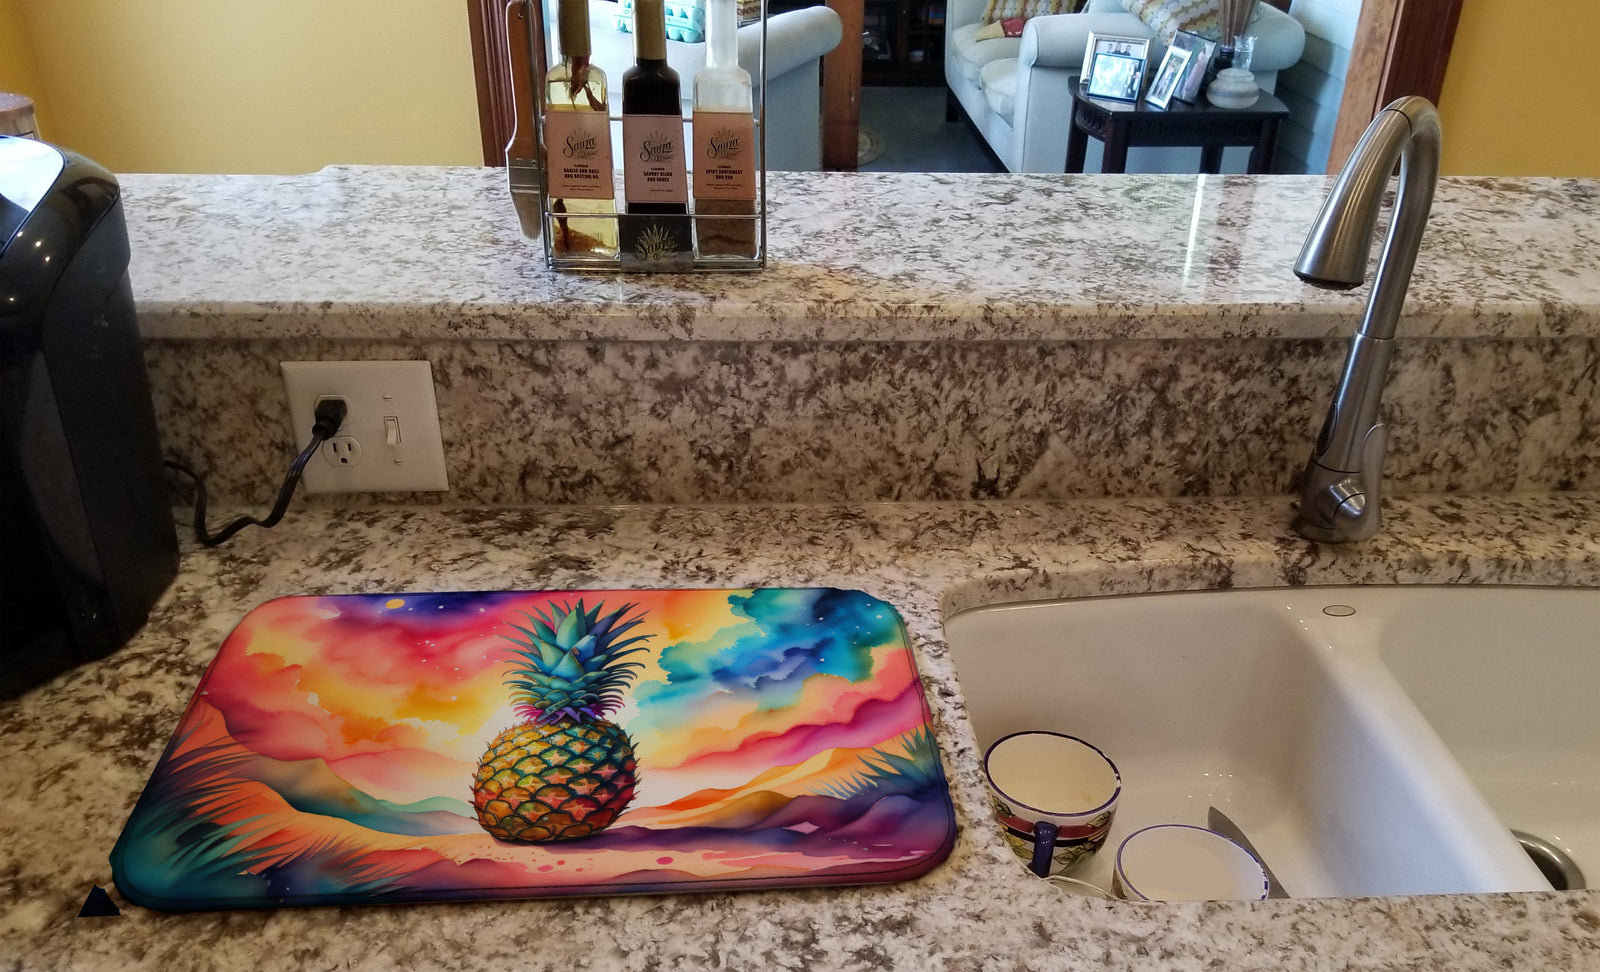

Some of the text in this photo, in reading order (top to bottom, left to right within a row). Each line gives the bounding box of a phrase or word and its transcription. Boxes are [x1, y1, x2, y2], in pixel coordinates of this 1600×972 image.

[563, 136, 598, 158] Sauza
[640, 140, 674, 162] Sauza
[706, 137, 741, 159] Sauza
